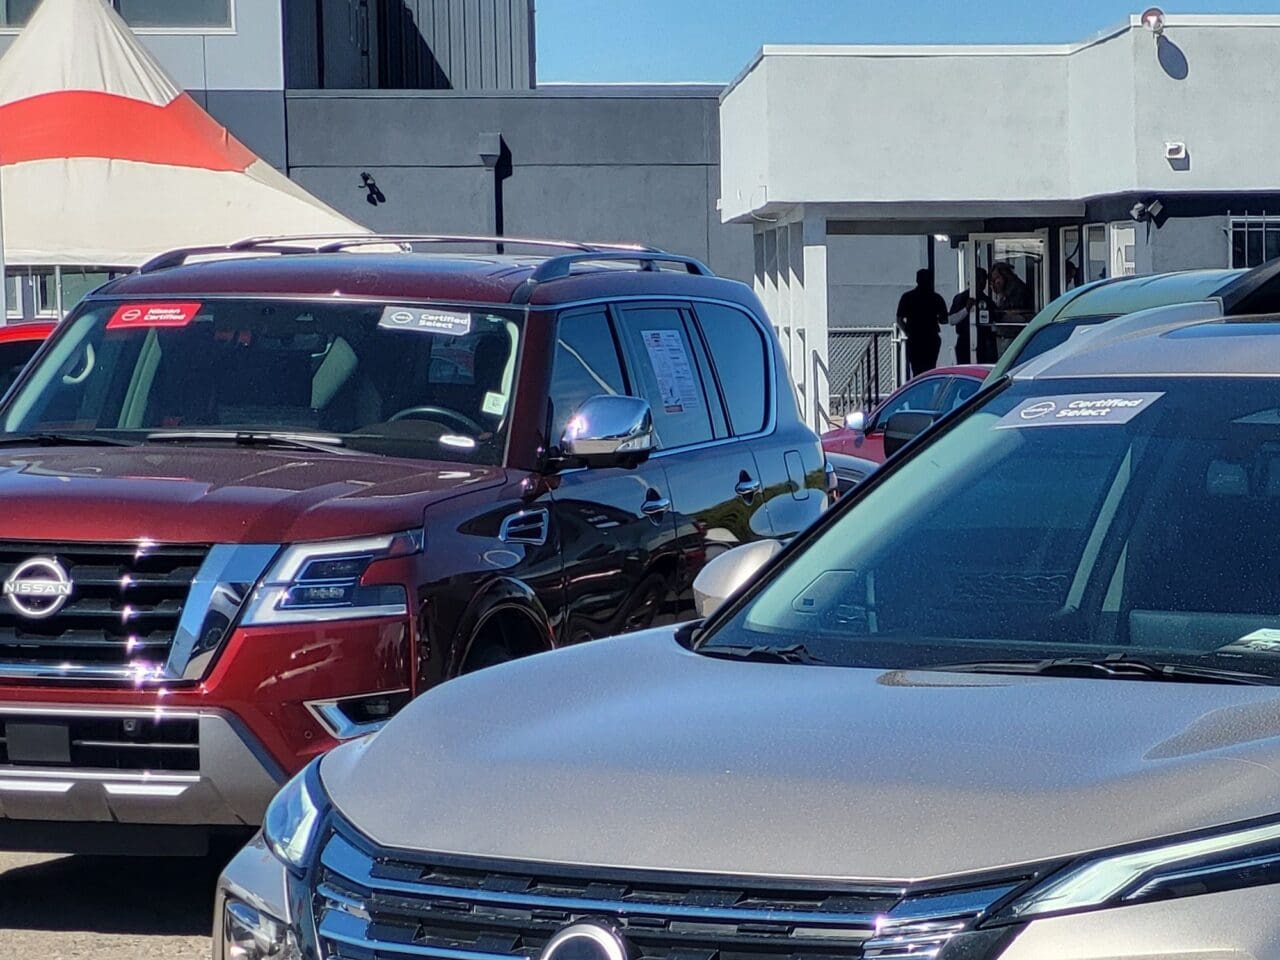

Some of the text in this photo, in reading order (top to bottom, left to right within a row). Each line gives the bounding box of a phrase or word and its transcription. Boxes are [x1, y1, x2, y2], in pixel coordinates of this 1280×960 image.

[418, 319, 454, 329] Select
[420, 313, 469, 325] Certified
[1068, 398, 1144, 409] Certified
[1055, 408, 1112, 418] Select
[4, 582, 71, 594] NISSAN
